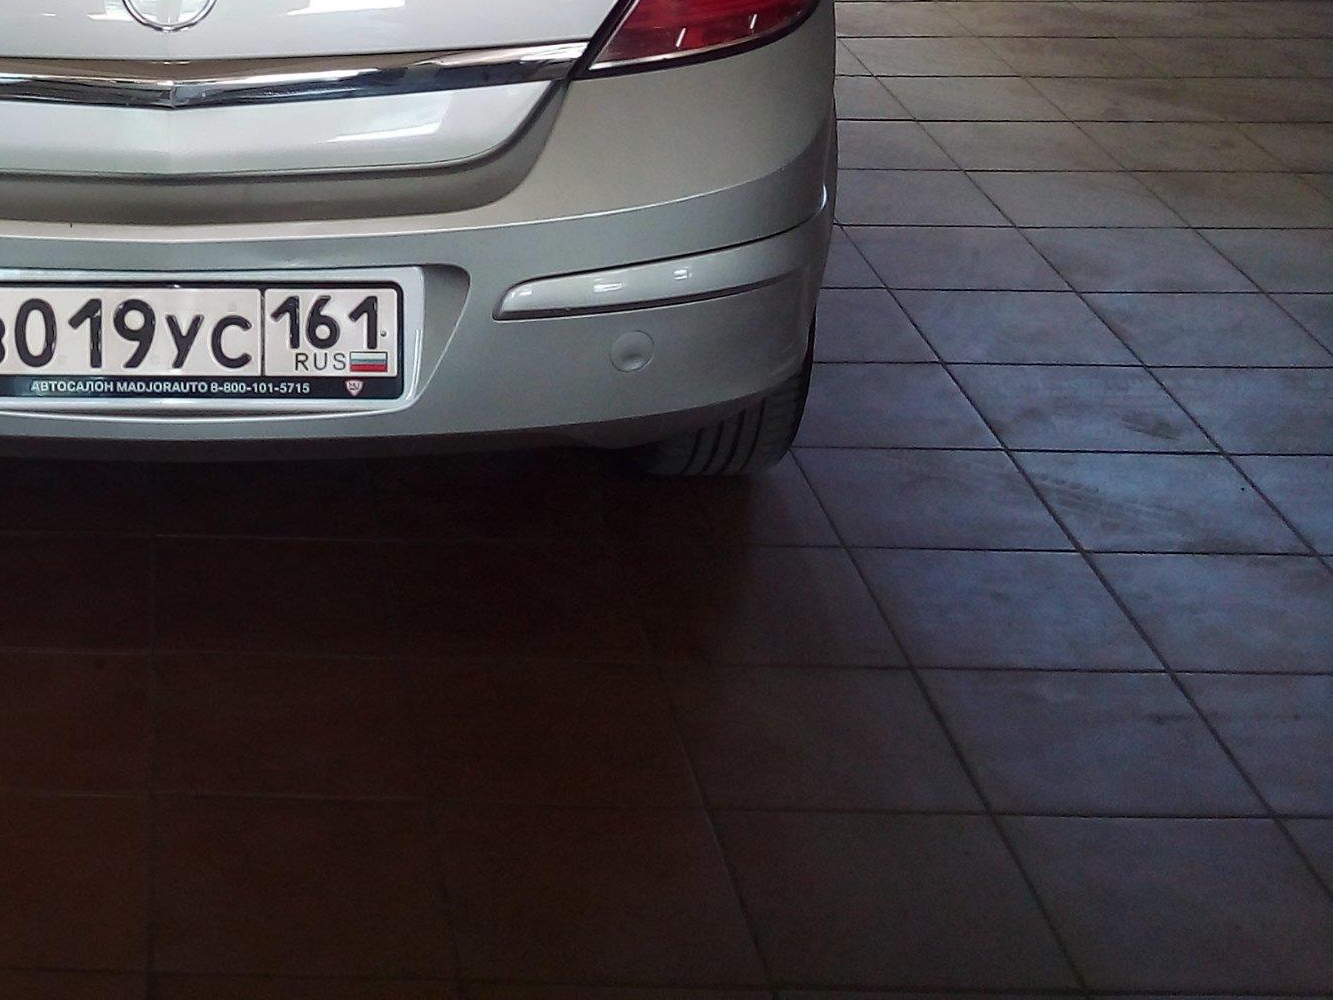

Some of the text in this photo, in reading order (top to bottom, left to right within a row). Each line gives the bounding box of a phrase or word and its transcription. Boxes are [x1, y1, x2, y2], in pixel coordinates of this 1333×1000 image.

[270, 294, 378, 350] 161
[294, 351, 347, 371] RUS
[30, 380, 311, 394] АВТОСАЛОН MADJORAUTO 8-800-101-5715
